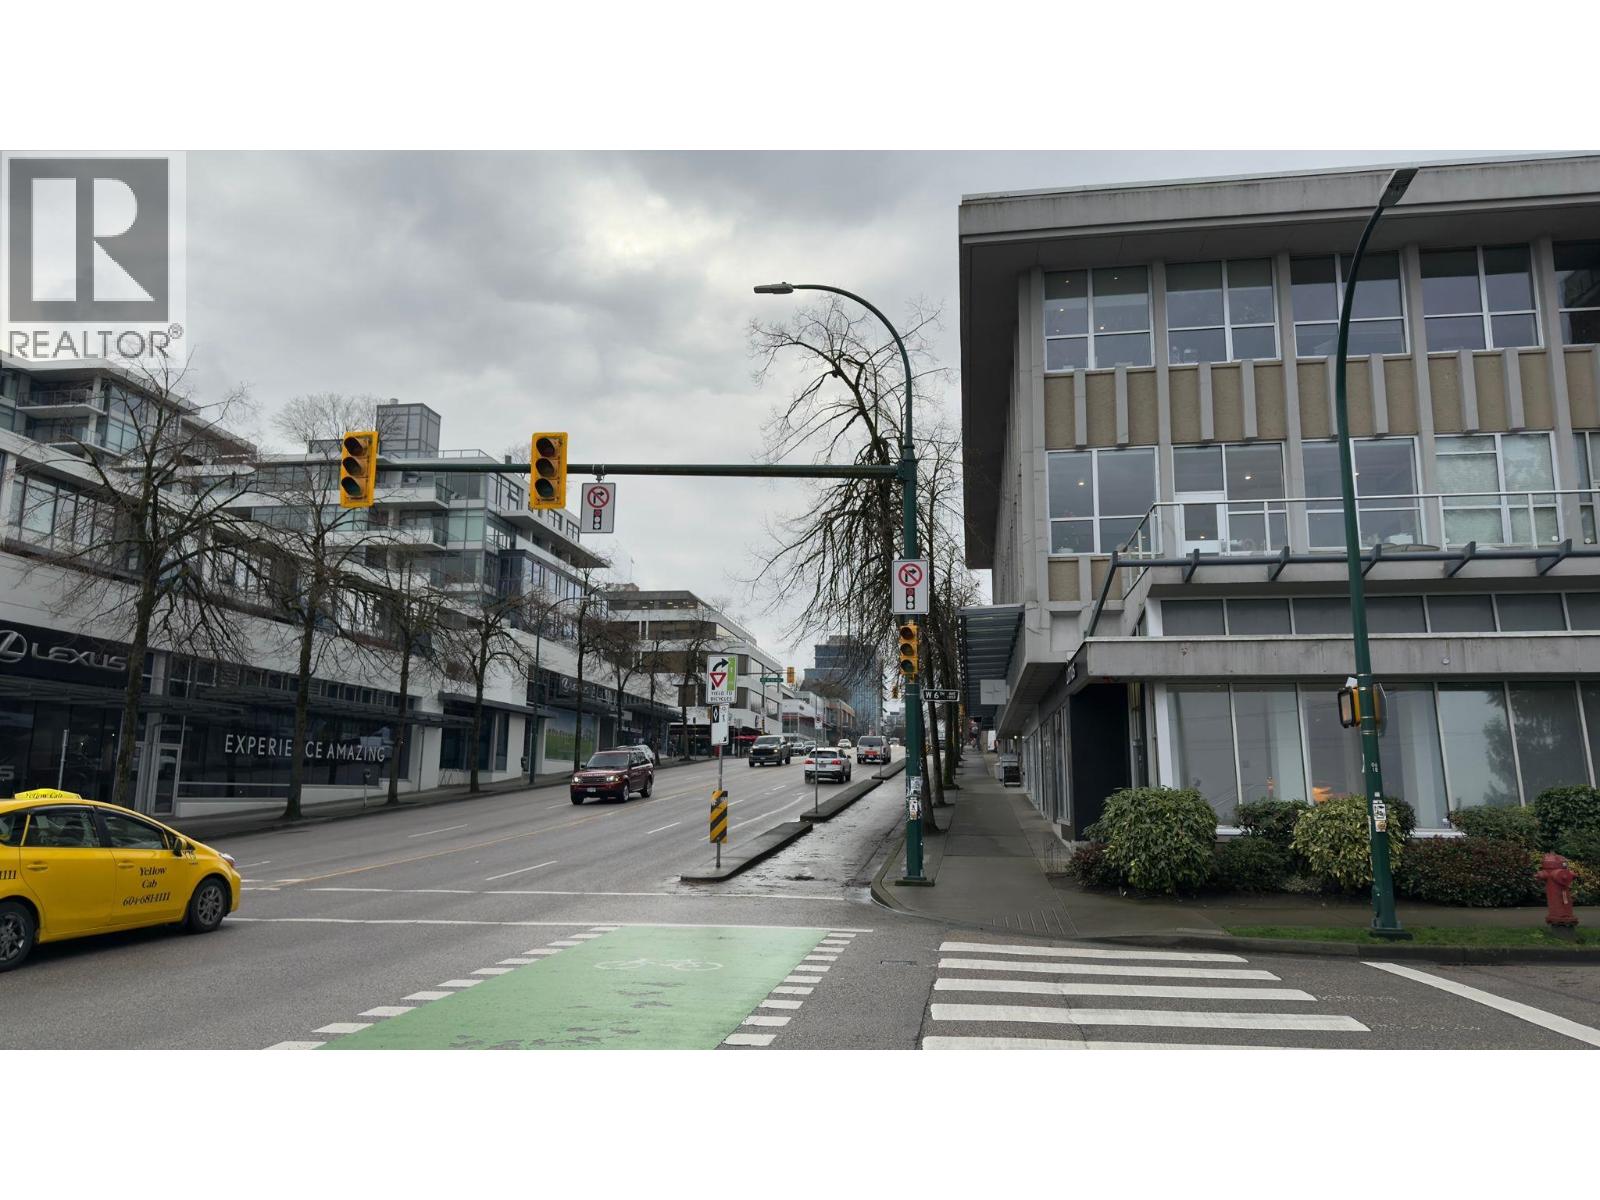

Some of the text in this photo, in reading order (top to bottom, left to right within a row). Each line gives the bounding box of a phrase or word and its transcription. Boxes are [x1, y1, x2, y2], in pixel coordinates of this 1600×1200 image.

[31, 642, 127, 671] LEXUS
[224, 734, 386, 762] EXPERIECE AMAZING
[139, 866, 167, 877] Yellow
[141, 879, 158, 889] Cab
